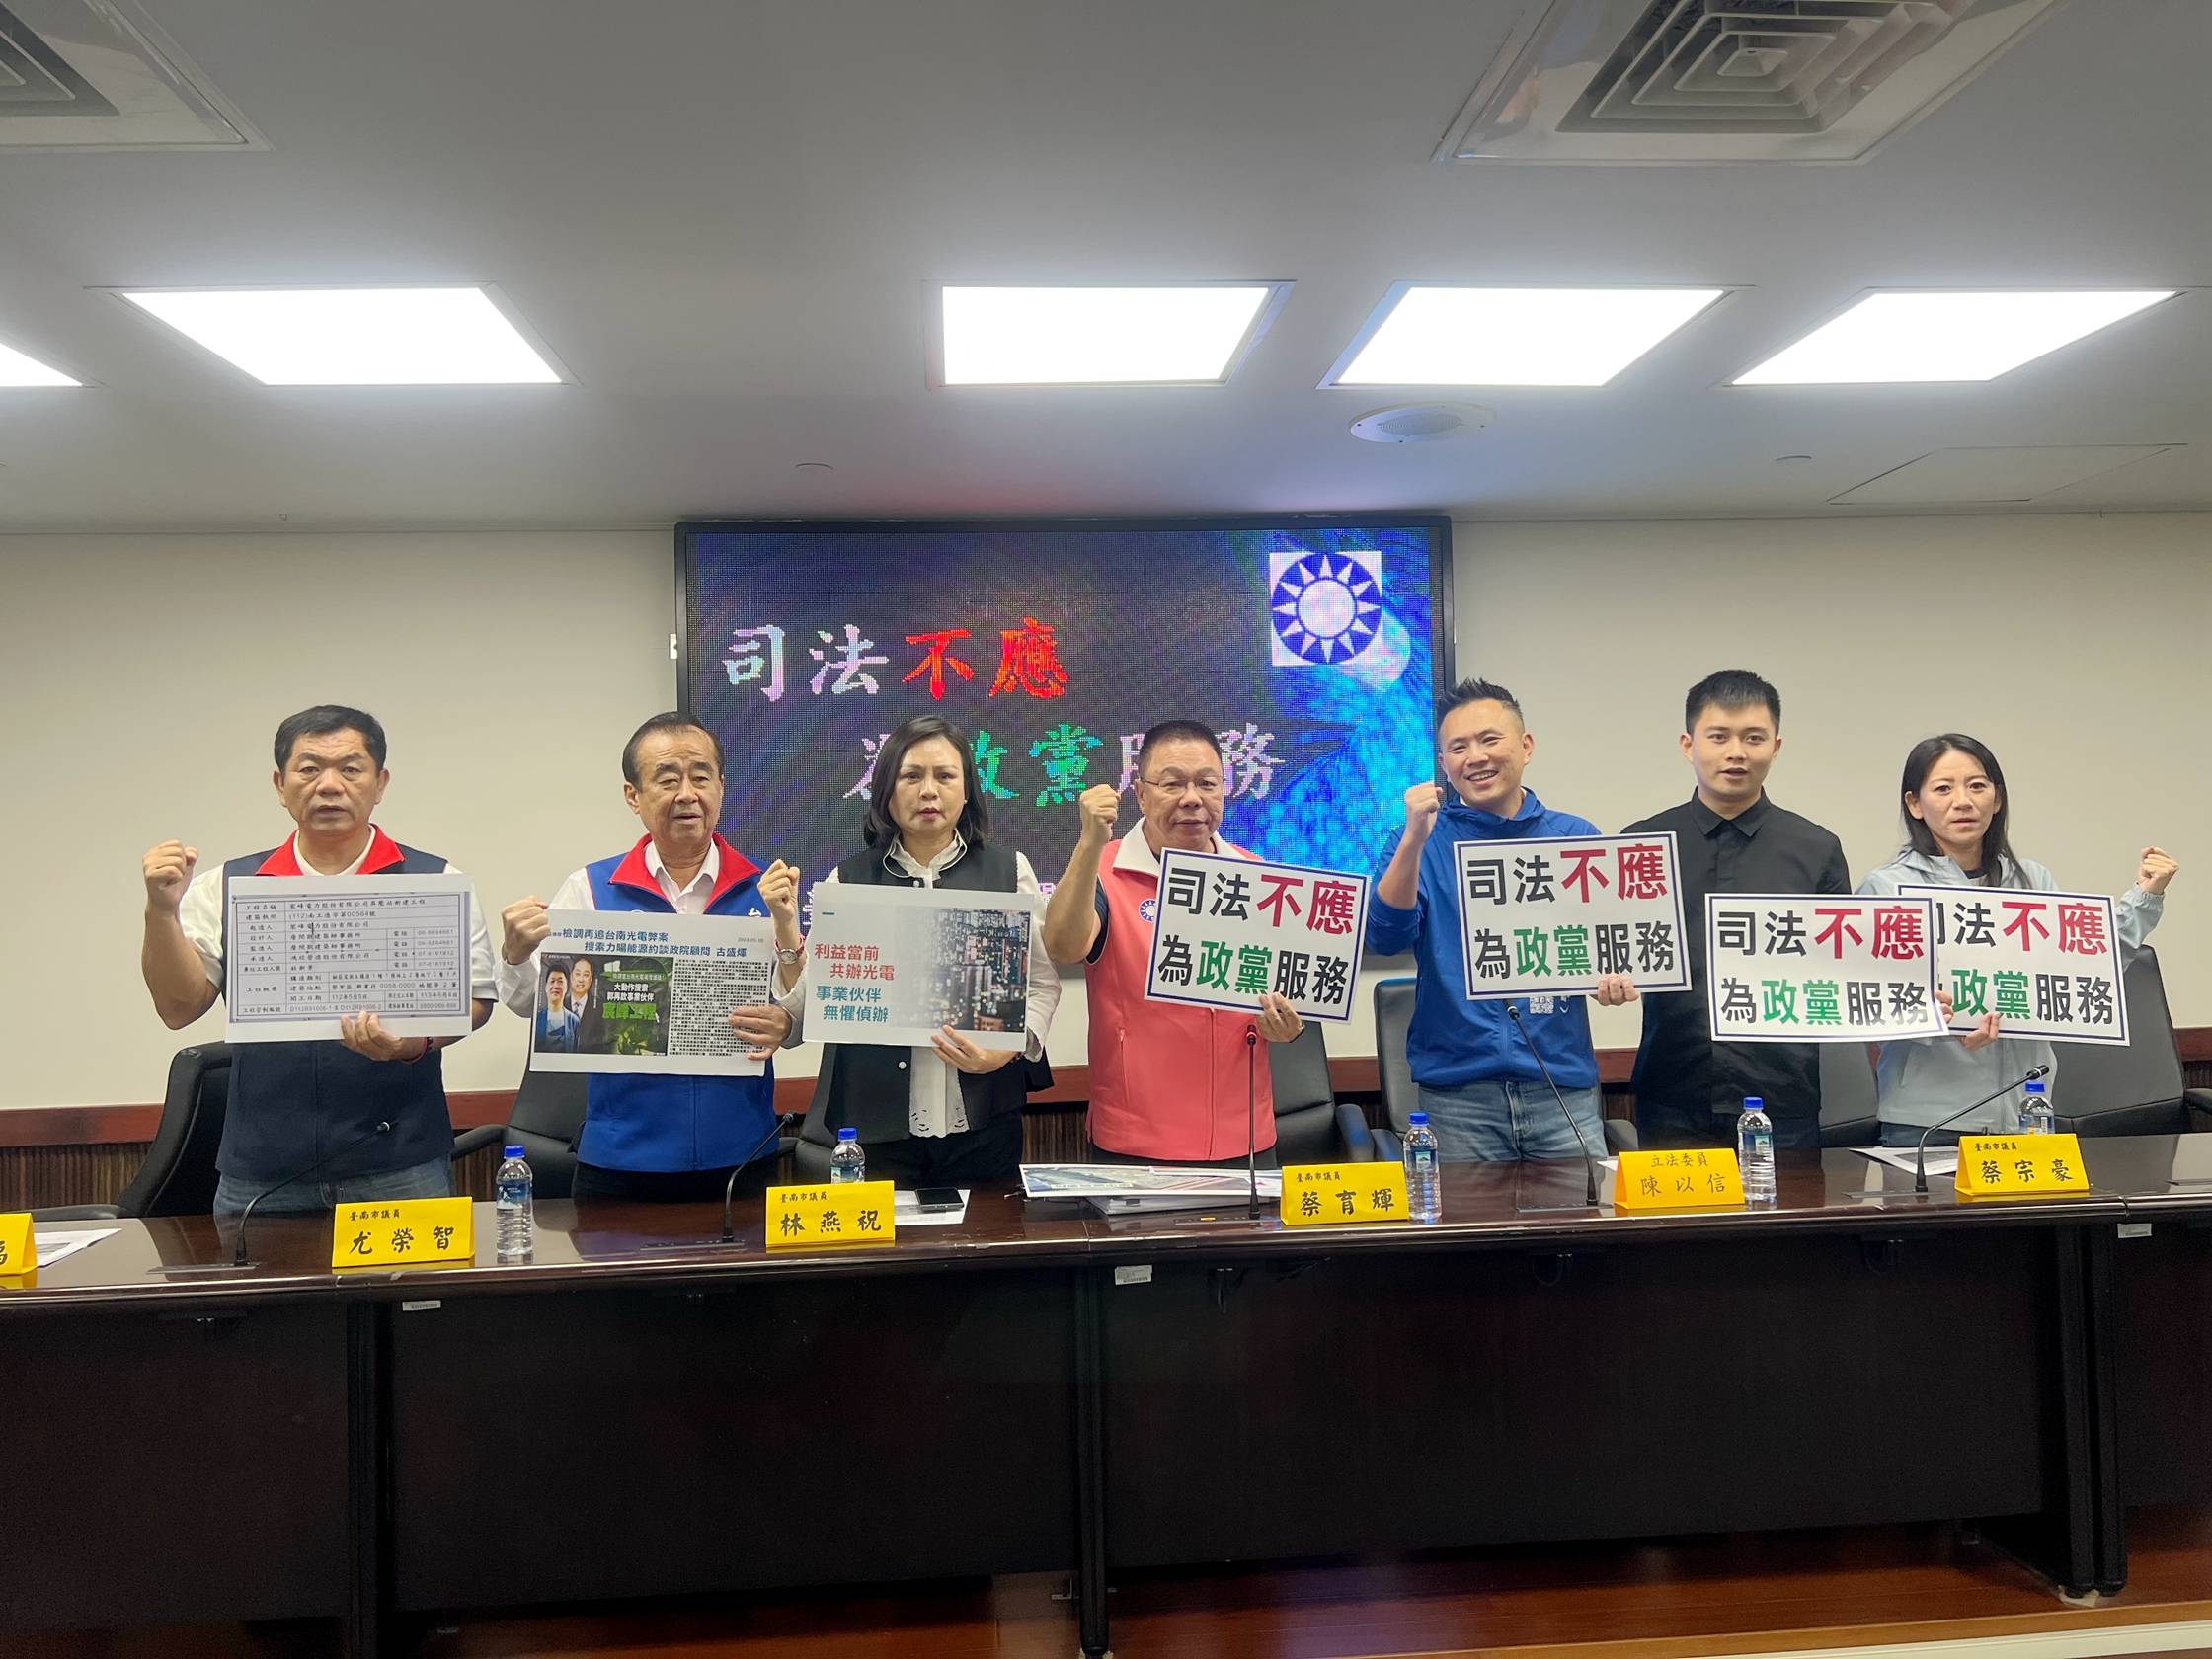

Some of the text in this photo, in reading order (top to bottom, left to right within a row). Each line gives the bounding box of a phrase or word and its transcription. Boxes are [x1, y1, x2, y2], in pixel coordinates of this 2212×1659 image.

[722, 616, 1069, 701] 司法不應
[1467, 843, 1668, 905] 司法不應
[1167, 867, 1358, 935] 司法不應
[562, 928, 669, 942] 檢調再追台南光電弊案
[1717, 906, 1925, 960] 司法不應
[815, 943, 879, 961] 利益當前
[1475, 920, 1674, 979] 為政黨服務
[830, 964, 895, 981] 共辦光電
[1158, 934, 1349, 1004] 為政黨服務
[817, 986, 882, 1002] 事業伙伴
[1720, 978, 1928, 1026] 為政黨服務
[1938, 969, 2113, 1024] 政黨服務
[824, 1005, 889, 1022] 無懼偵辦
[1975, 1142, 2017, 1151] 臺南市議員
[1651, 1152, 1708, 1167] 立法委員
[1982, 1159, 2073, 1184] 蔡宗豪
[1296, 1171, 1341, 1182] 臺南市議員
[1640, 1174, 1725, 1197] 陳以信
[780, 1191, 829, 1203] 臺南市議員
[1301, 1188, 1394, 1217] 蔡育輝
[349, 1209, 400, 1221] 臺南市議員
[780, 1210, 881, 1237] 林燕祝
[349, 1225, 454, 1254] 尤榮智
